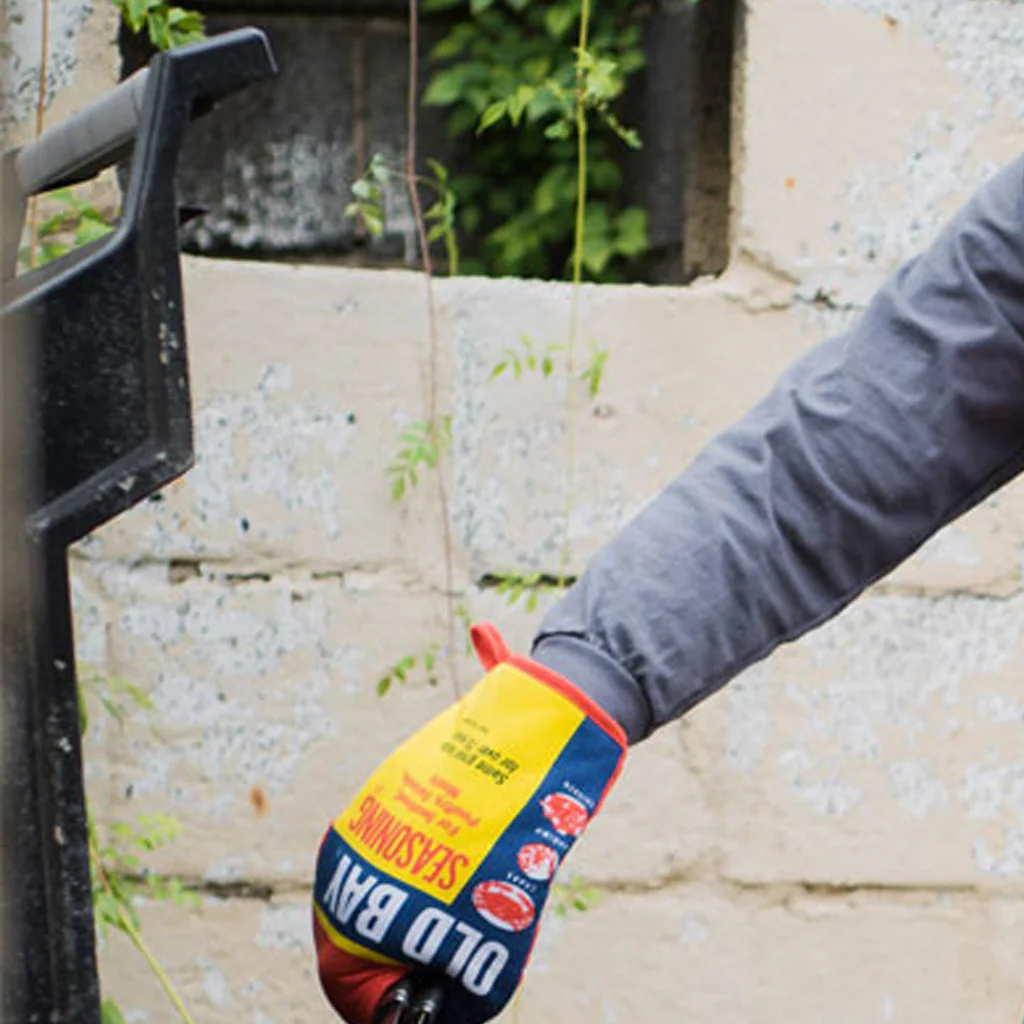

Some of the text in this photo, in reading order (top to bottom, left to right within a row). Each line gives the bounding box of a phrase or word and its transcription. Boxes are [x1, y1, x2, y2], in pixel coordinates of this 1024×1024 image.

[348, 795, 469, 891] SEASONING
[323, 854, 509, 996] OLD BAY
